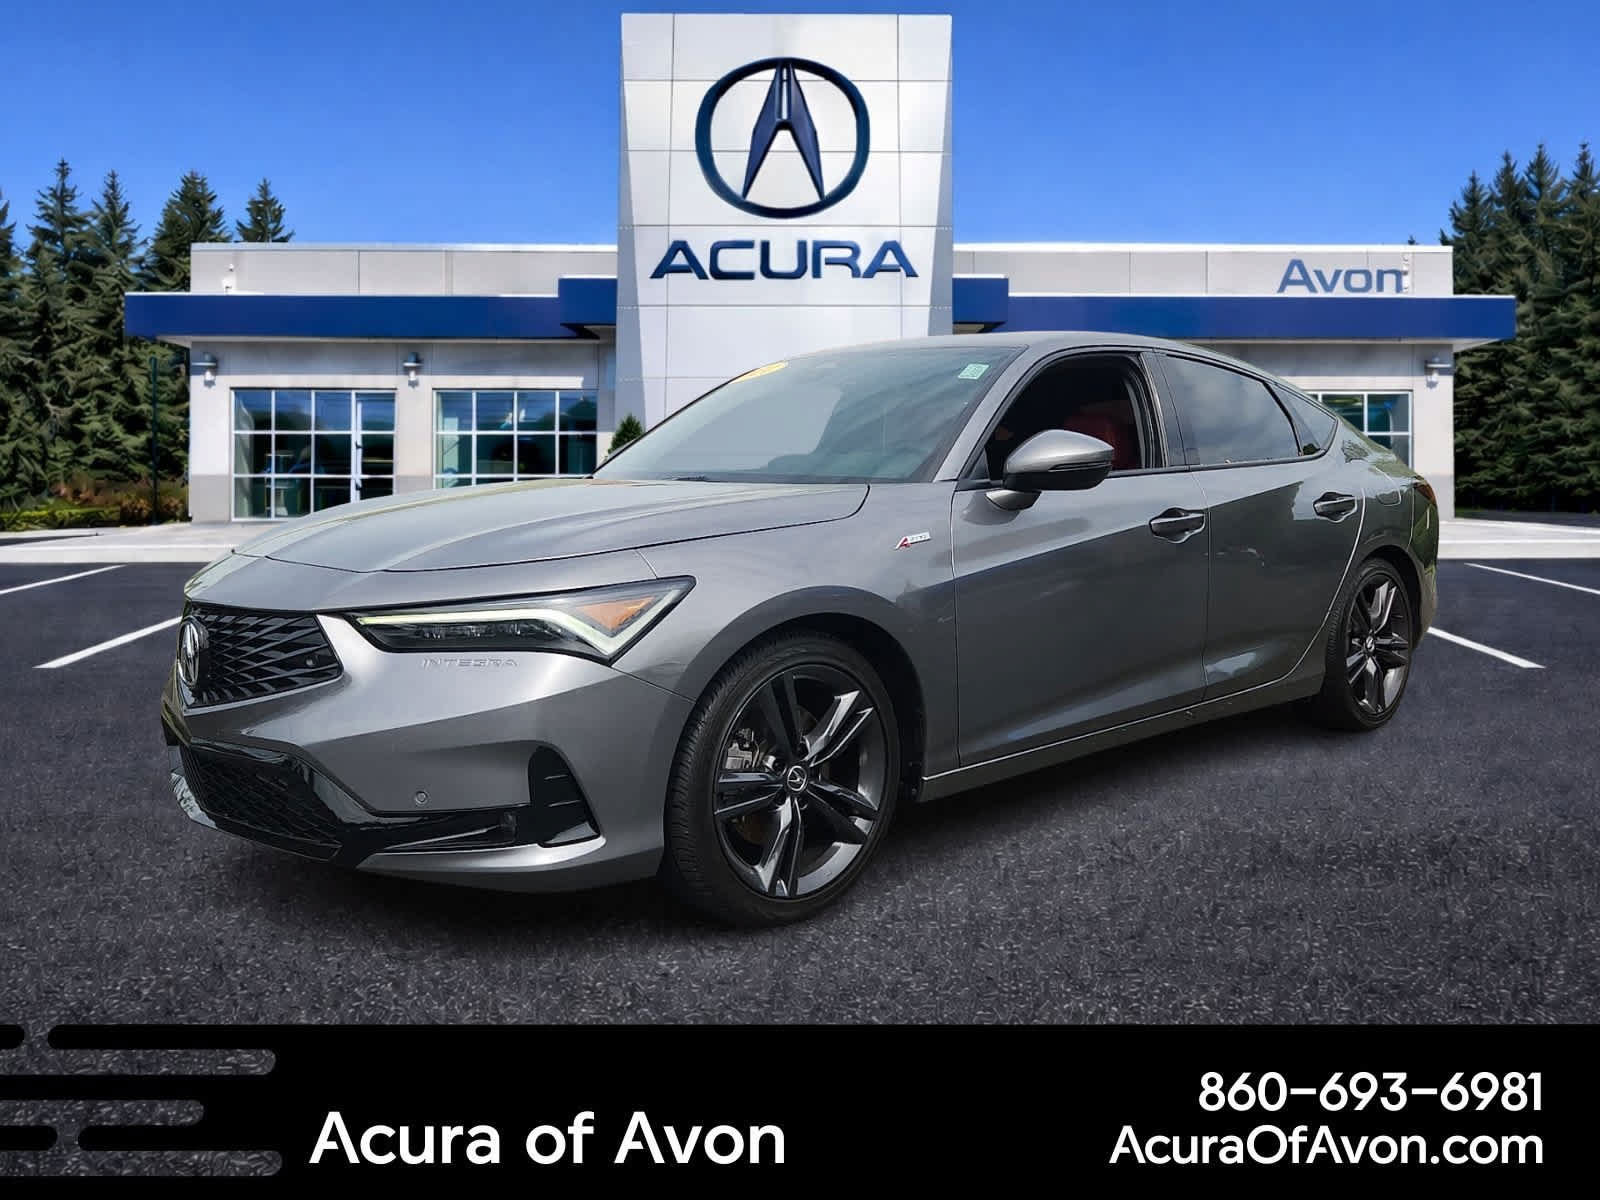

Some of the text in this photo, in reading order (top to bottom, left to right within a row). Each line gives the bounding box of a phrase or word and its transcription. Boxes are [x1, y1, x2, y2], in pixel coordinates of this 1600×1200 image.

[650, 240, 919, 281] ACURA
[1277, 259, 1404, 294] Avon
[421, 657, 519, 669] INTEGRA
